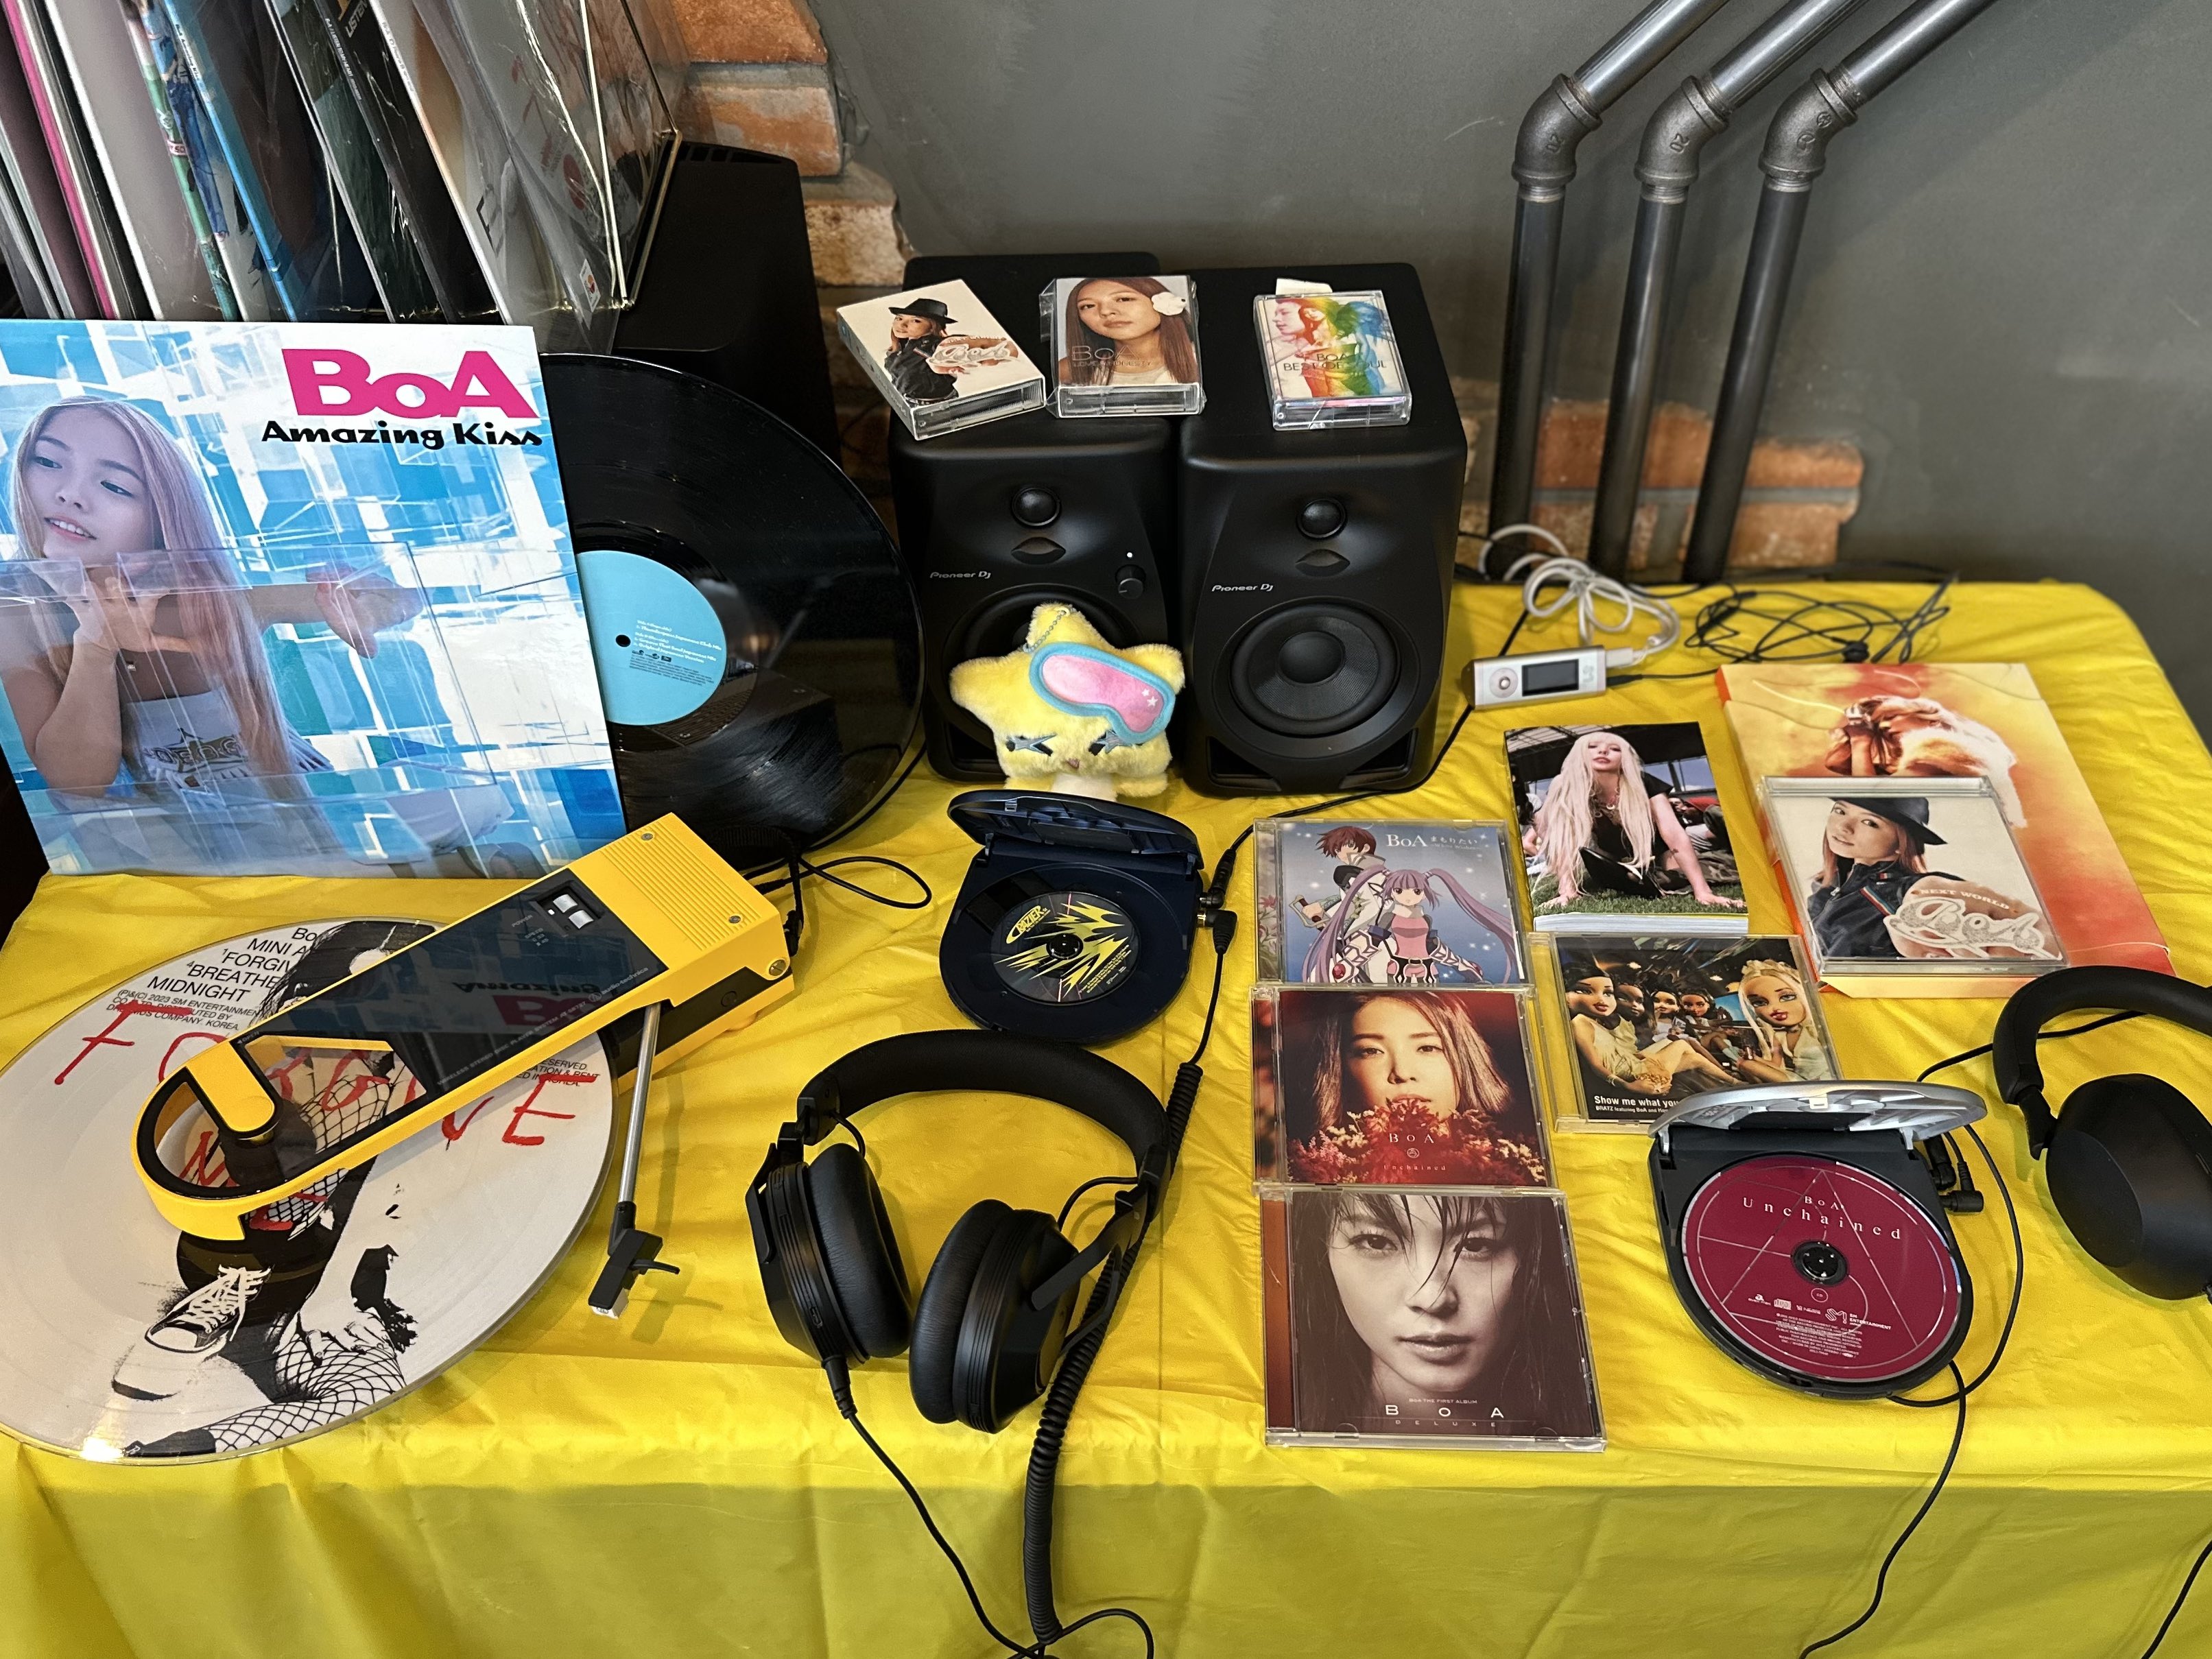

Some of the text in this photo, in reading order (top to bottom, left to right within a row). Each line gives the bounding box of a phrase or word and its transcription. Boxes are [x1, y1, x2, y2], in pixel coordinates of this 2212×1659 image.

[1072, 345, 1141, 361] BoA
[282, 348, 539, 419] BoA
[261, 421, 543, 450] Amazing Kiss
[1386, 834, 1429, 847] BoA
[1960, 891, 2010, 909] WORLD
[291, 927, 317, 942] Bo
[248, 938, 310, 957] MINI A
[147, 976, 251, 1002] MIDNIGHT
[147, 994, 171, 1003] 2023
[171, 998, 187, 1006] SM
[189, 1000, 259, 1017] ENTERTAINMEN
[217, 1012, 232, 1021] BY
[531, 1065, 562, 1076] ATION
[541, 1058, 588, 1071] ESERVED.
[1594, 1095, 1619, 1105] Show
[1638, 1098, 1661, 1107] what
[1388, 1133, 1435, 1144] BoA
[1804, 1196, 1840, 1211] BoA
[1742, 1197, 1901, 1240] Unchained
[1385, 1405, 1504, 1418] BOA
[1395, 1419, 1496, 1427] DELUXE
